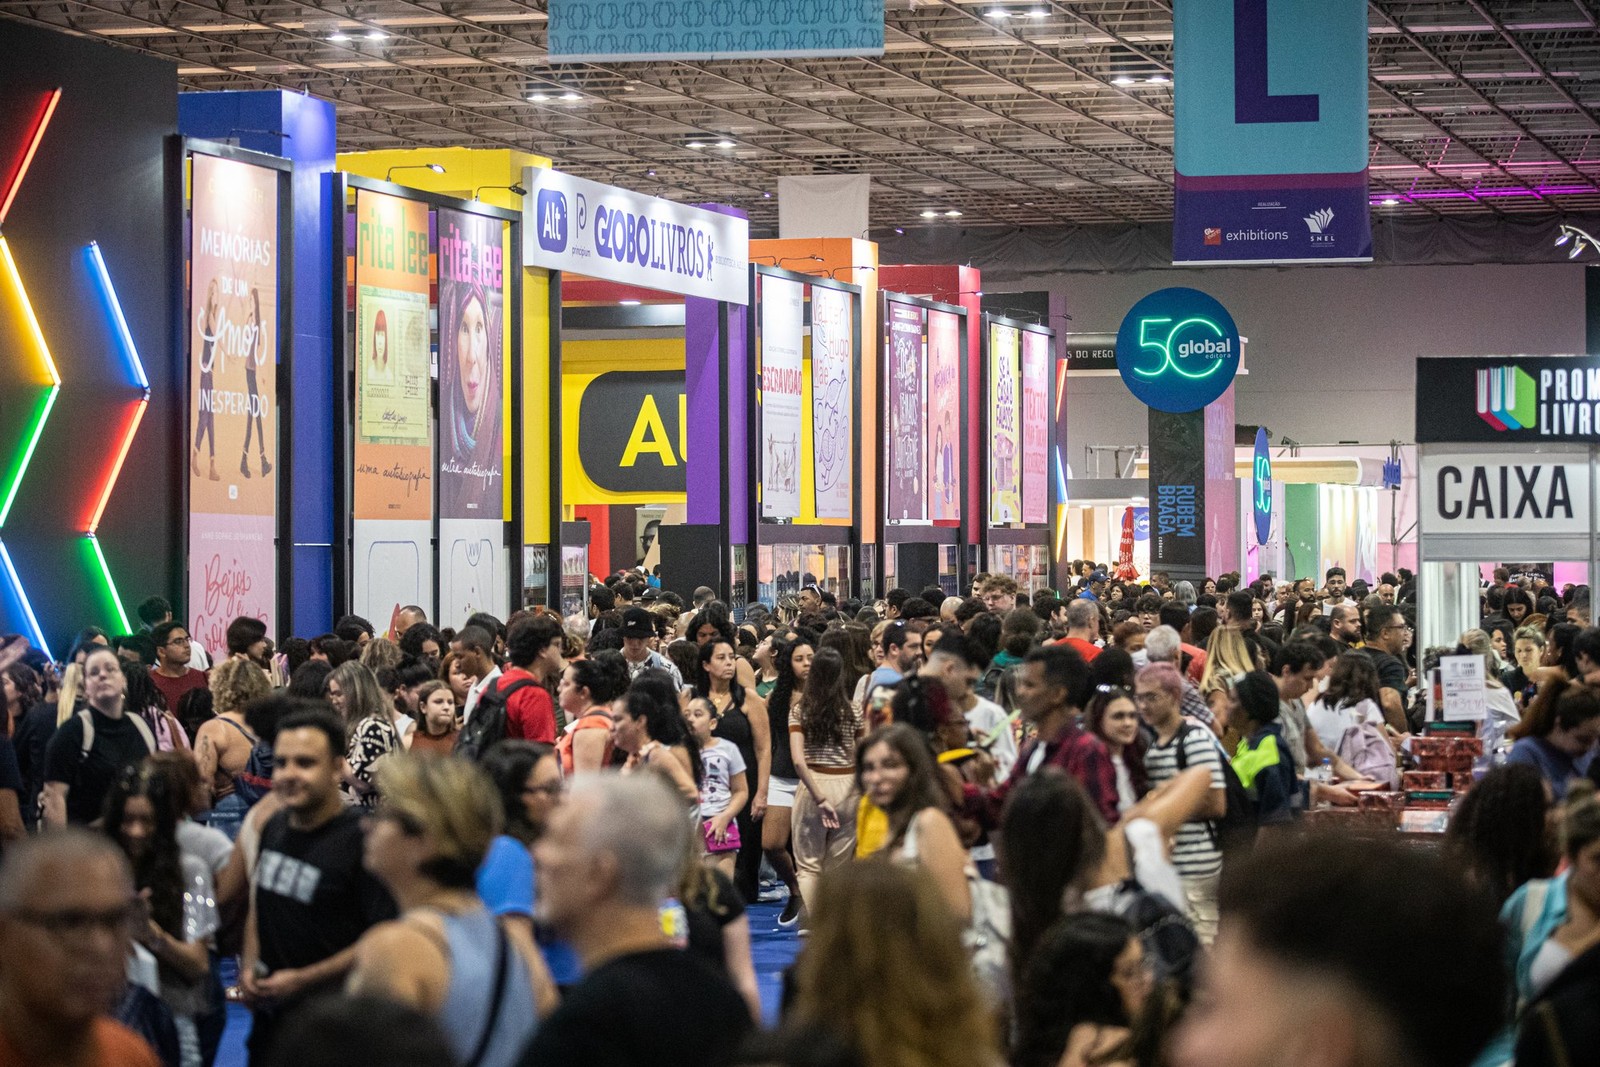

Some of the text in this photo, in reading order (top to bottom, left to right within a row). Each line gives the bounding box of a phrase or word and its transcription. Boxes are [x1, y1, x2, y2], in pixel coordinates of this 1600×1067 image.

[1234, 0, 1319, 124] L
[359, 205, 428, 276] rita lee
[542, 201, 561, 240] Alt
[1226, 229, 1288, 241] exhibitions
[200, 224, 270, 266] MEMÓRIAS
[440, 220, 502, 288] rita lee
[572, 246, 591, 259] principium
[222, 276, 248, 297] DE UM
[1076, 350, 1088, 358] DO
[1092, 350, 1114, 358] REGO
[1178, 338, 1231, 358] global
[198, 388, 269, 418] INESPERADO
[357, 463, 378, 474] uma
[1158, 485, 1176, 536] BRAGA
[1176, 485, 1196, 537] RUBEM
[1437, 466, 1574, 520] CAIXA
[204, 554, 251, 618] Beijos
